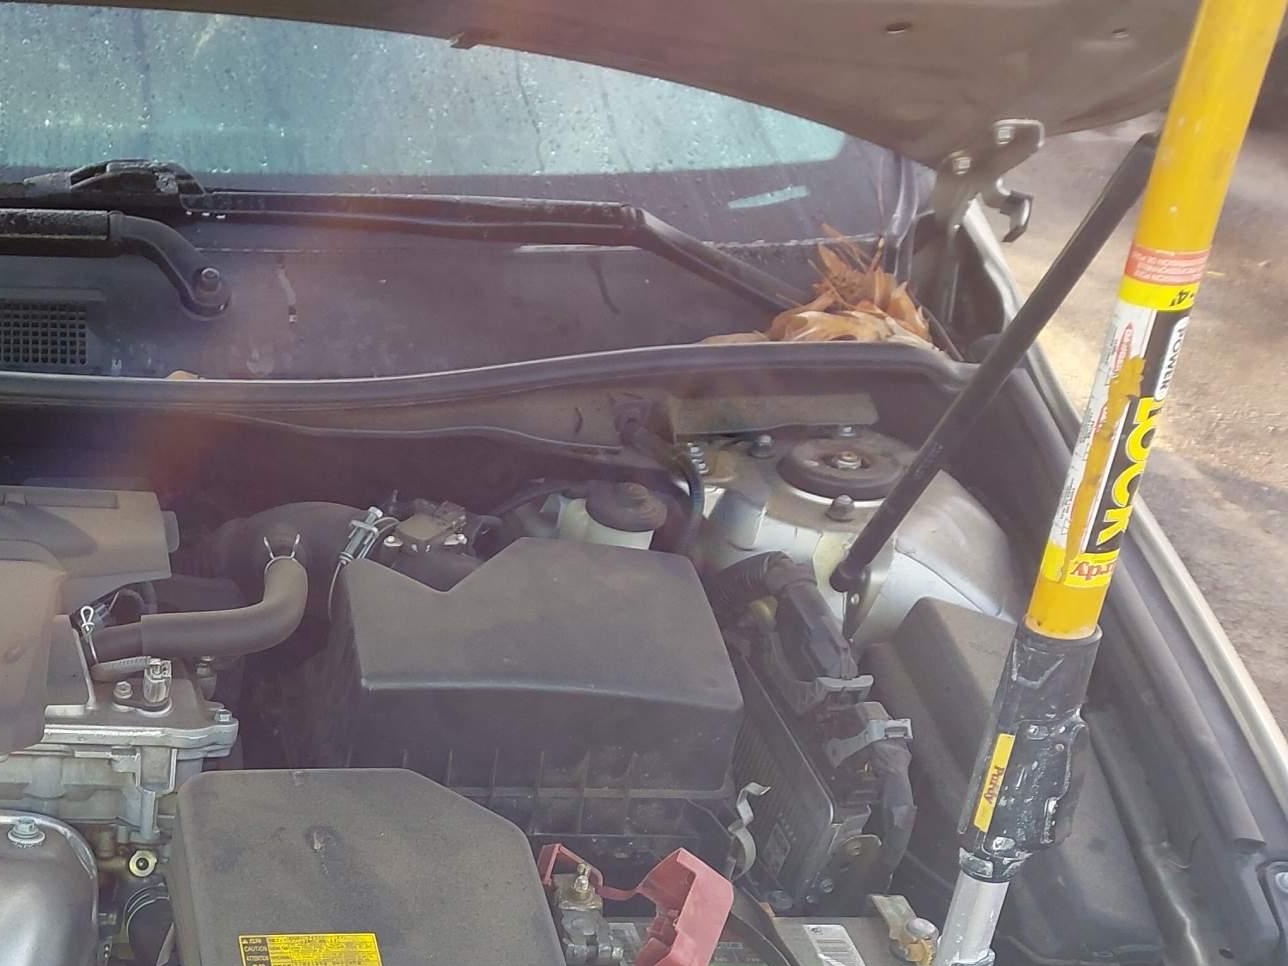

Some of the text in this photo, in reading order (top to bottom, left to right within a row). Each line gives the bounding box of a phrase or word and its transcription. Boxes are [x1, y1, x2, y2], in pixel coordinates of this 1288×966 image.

[1096, 396, 1166, 546] LOCK
[983, 764, 1005, 804] Purdy
[244, 945, 267, 953] CAUTION
